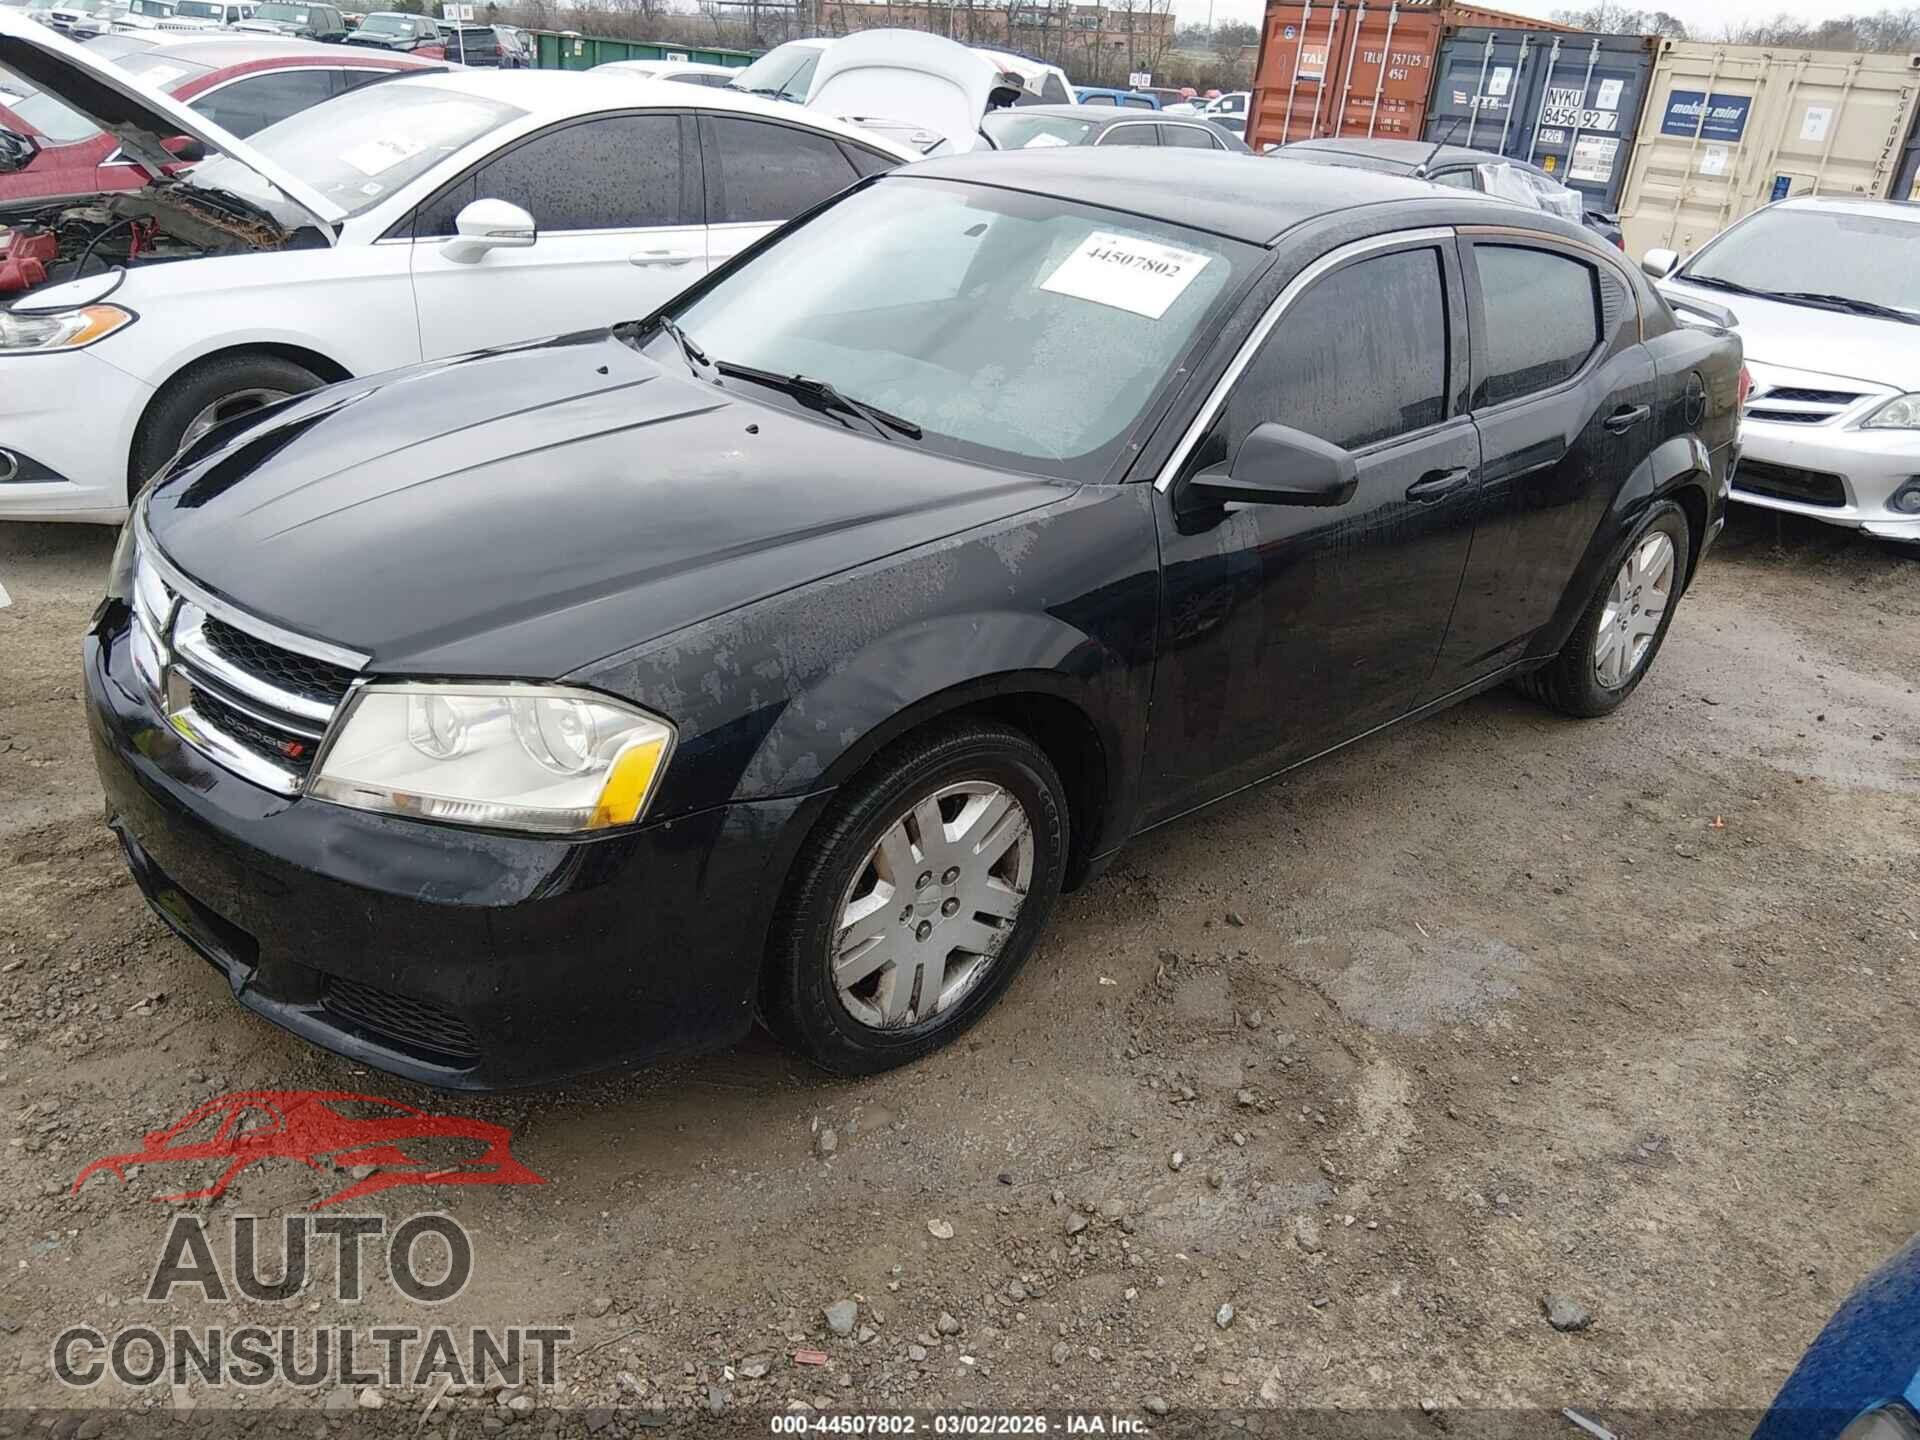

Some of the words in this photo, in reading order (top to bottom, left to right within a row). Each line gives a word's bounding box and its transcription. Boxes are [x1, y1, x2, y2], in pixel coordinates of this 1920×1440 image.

[1363, 51, 1383, 64] TRLU
[1392, 53, 1422, 66] 757125
[1547, 89, 1583, 108] NYKU
[1086, 247, 1182, 277] 44507802
